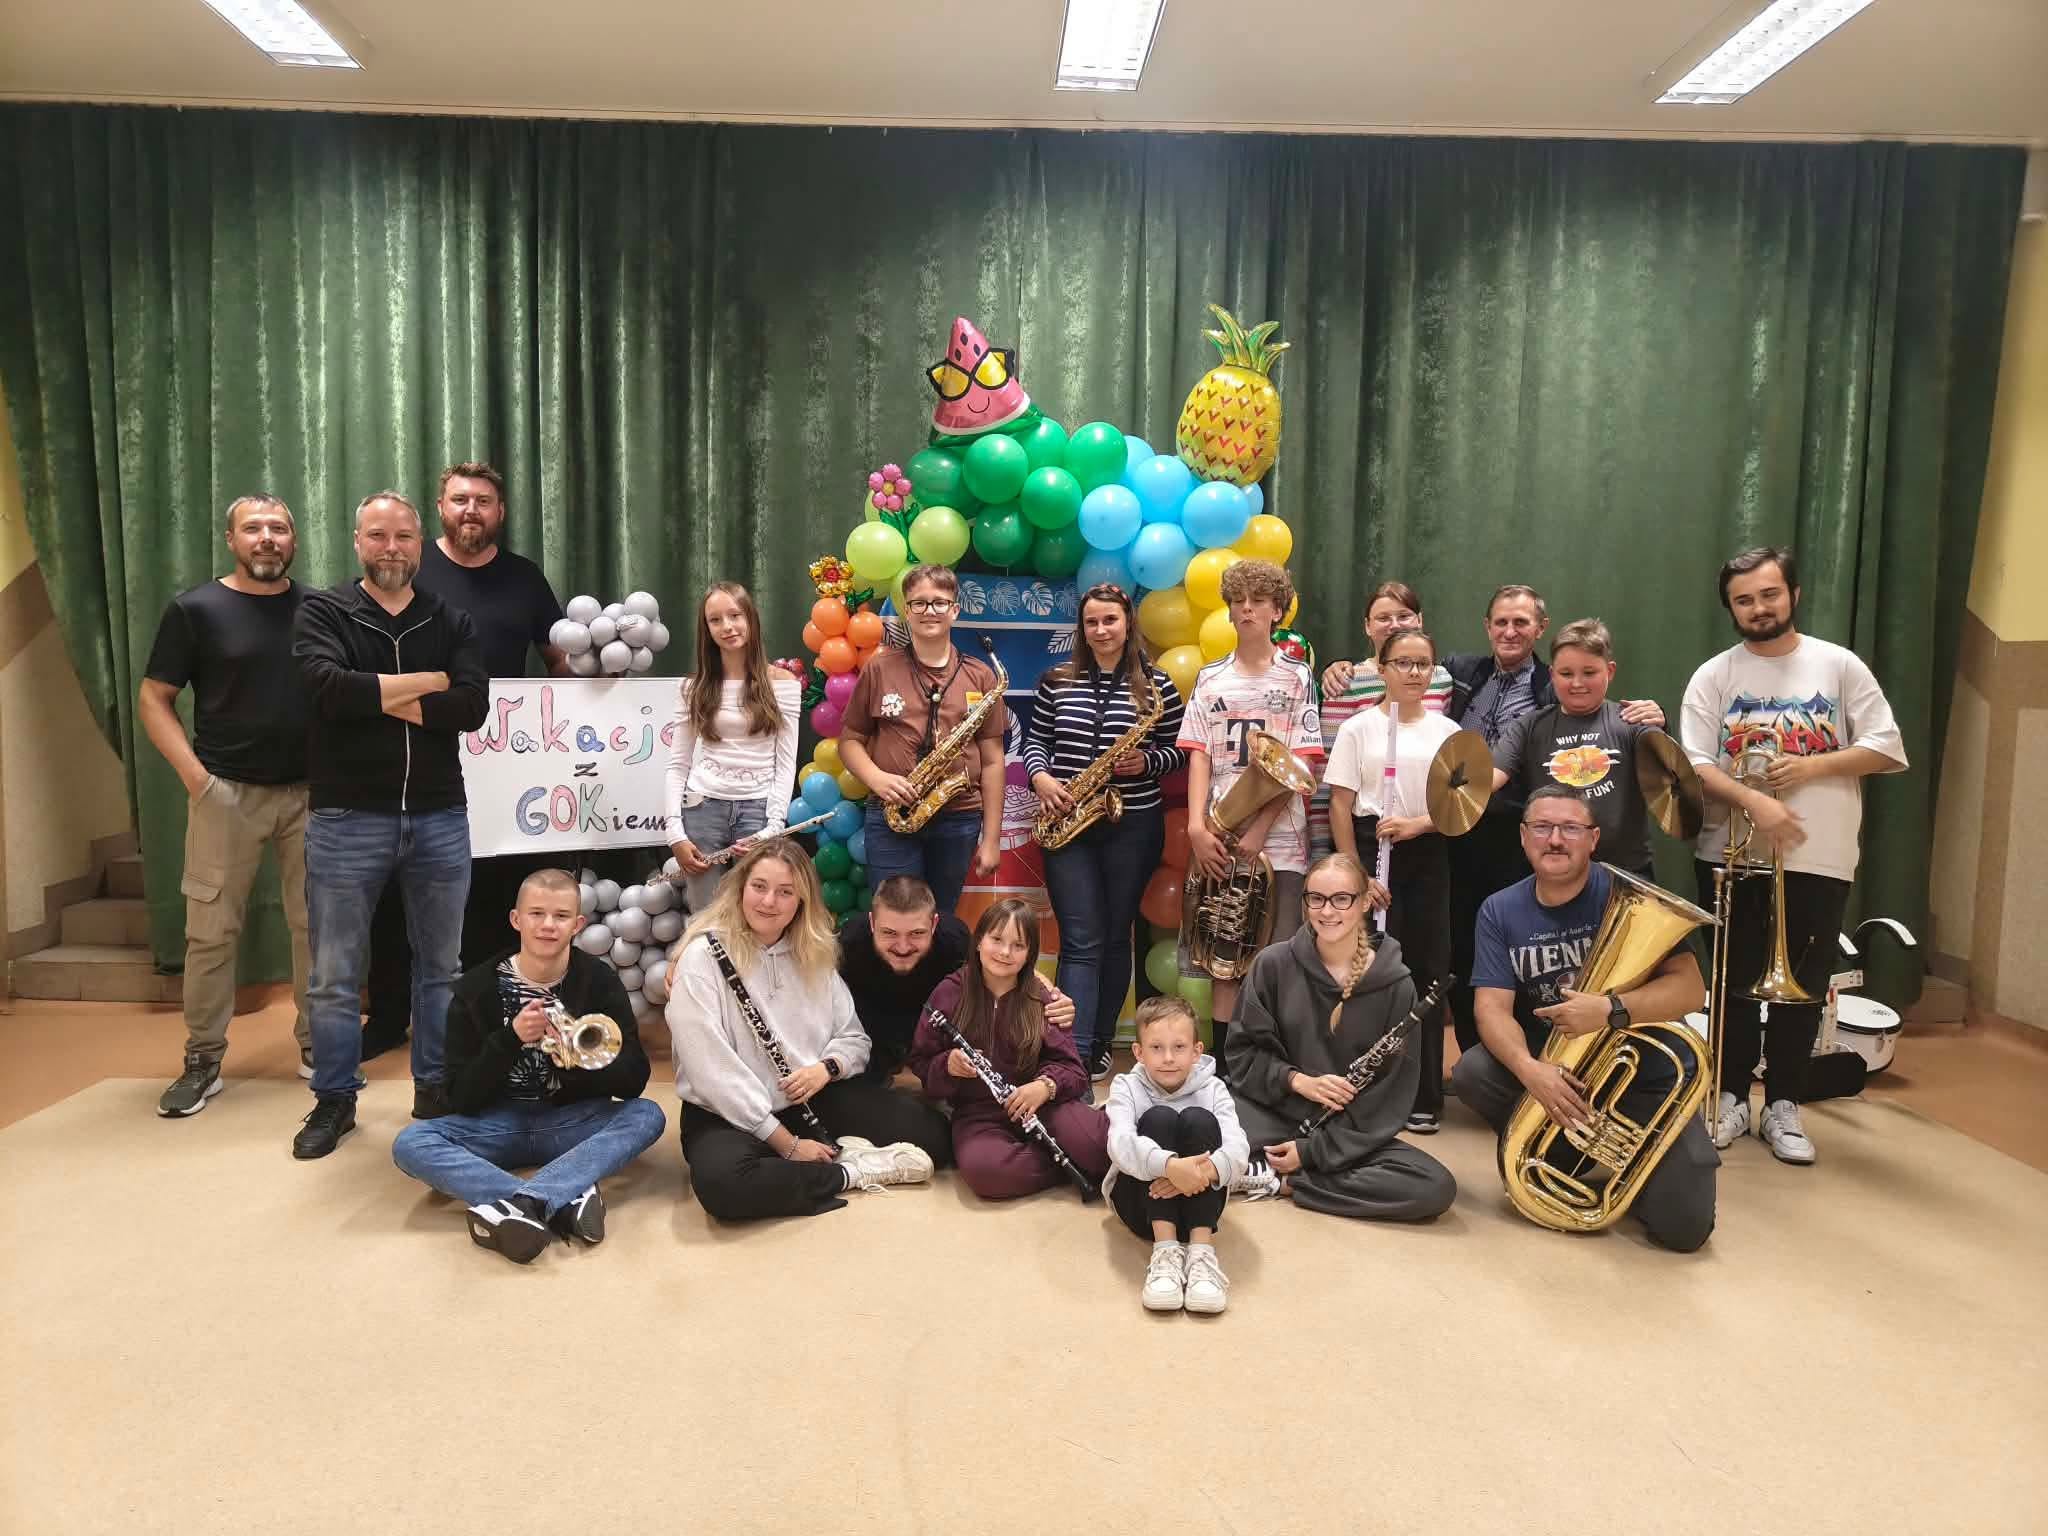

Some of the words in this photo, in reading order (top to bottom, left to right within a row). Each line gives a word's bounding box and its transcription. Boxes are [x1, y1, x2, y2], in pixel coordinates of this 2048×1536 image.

[1556, 734, 1578, 745] WHY
[1581, 733, 1600, 741] NOT
[1585, 780, 1615, 798] FUN?
